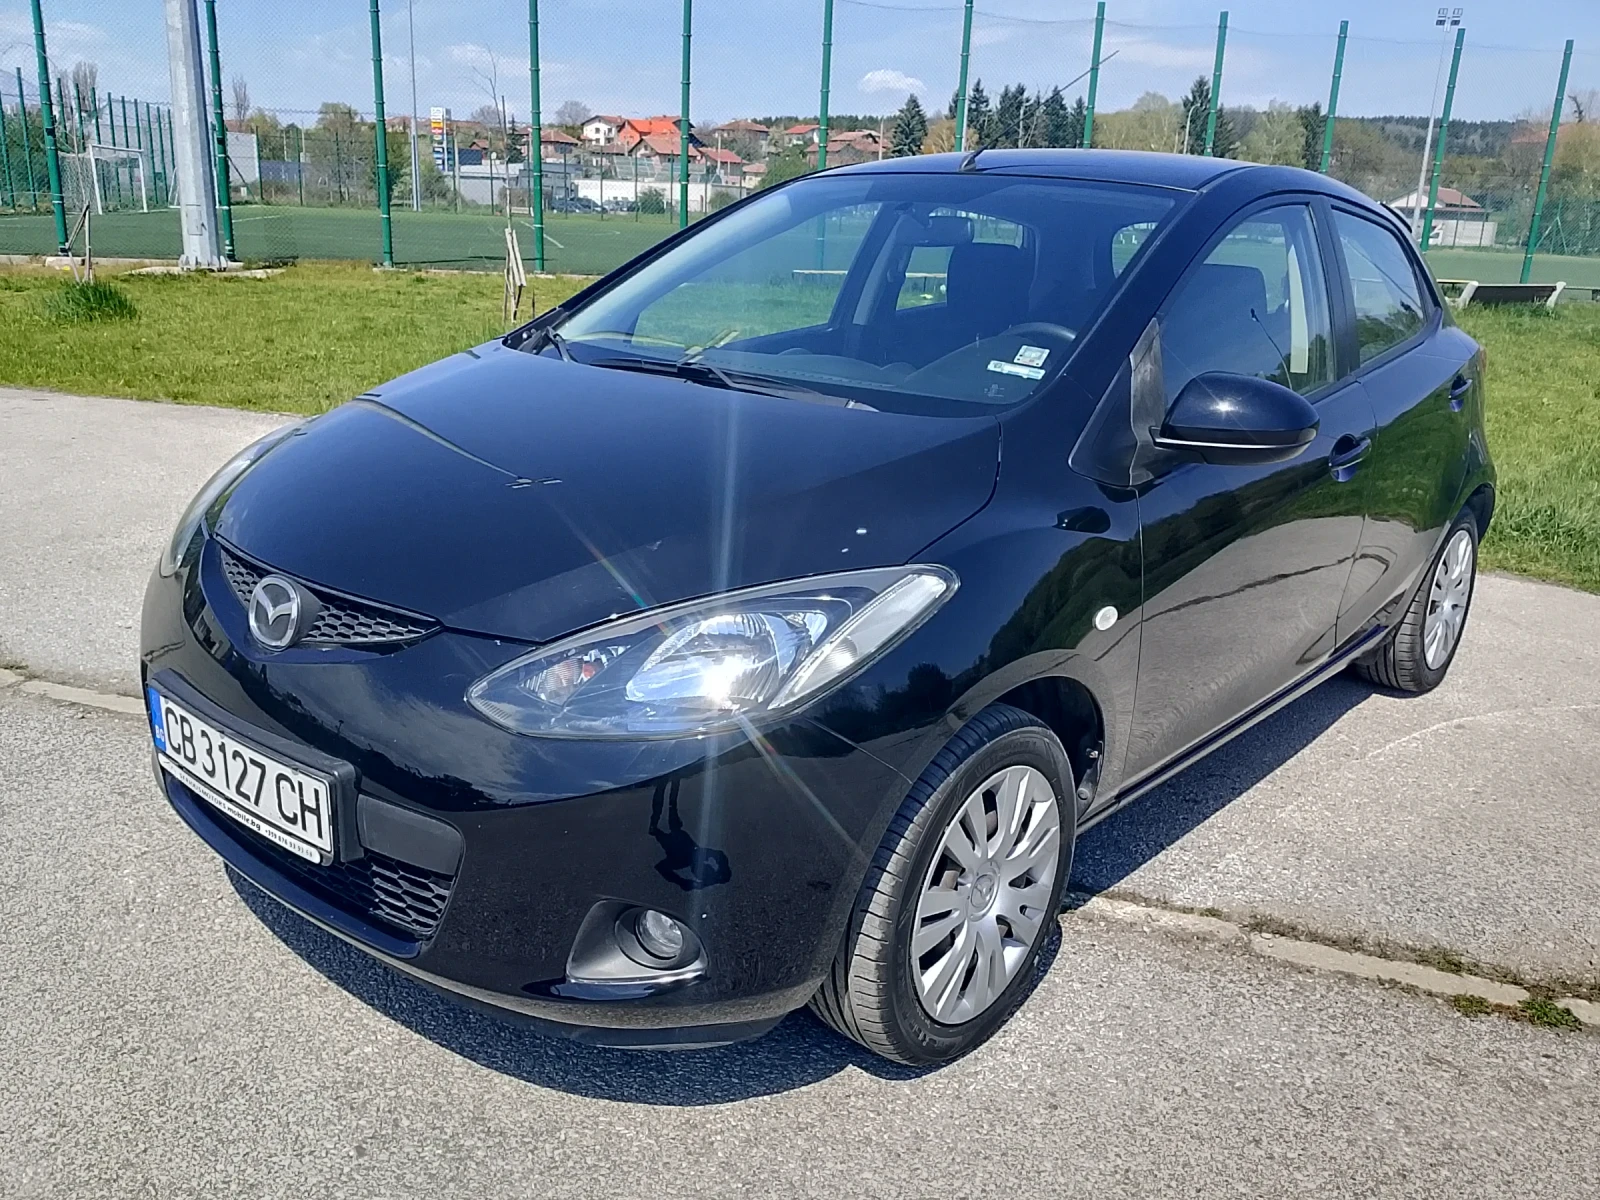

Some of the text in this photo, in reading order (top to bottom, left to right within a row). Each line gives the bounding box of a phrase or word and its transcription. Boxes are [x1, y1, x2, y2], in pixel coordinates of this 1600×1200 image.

[155, 725, 165, 743] BG
[165, 706, 323, 840] CB 3127 CH
